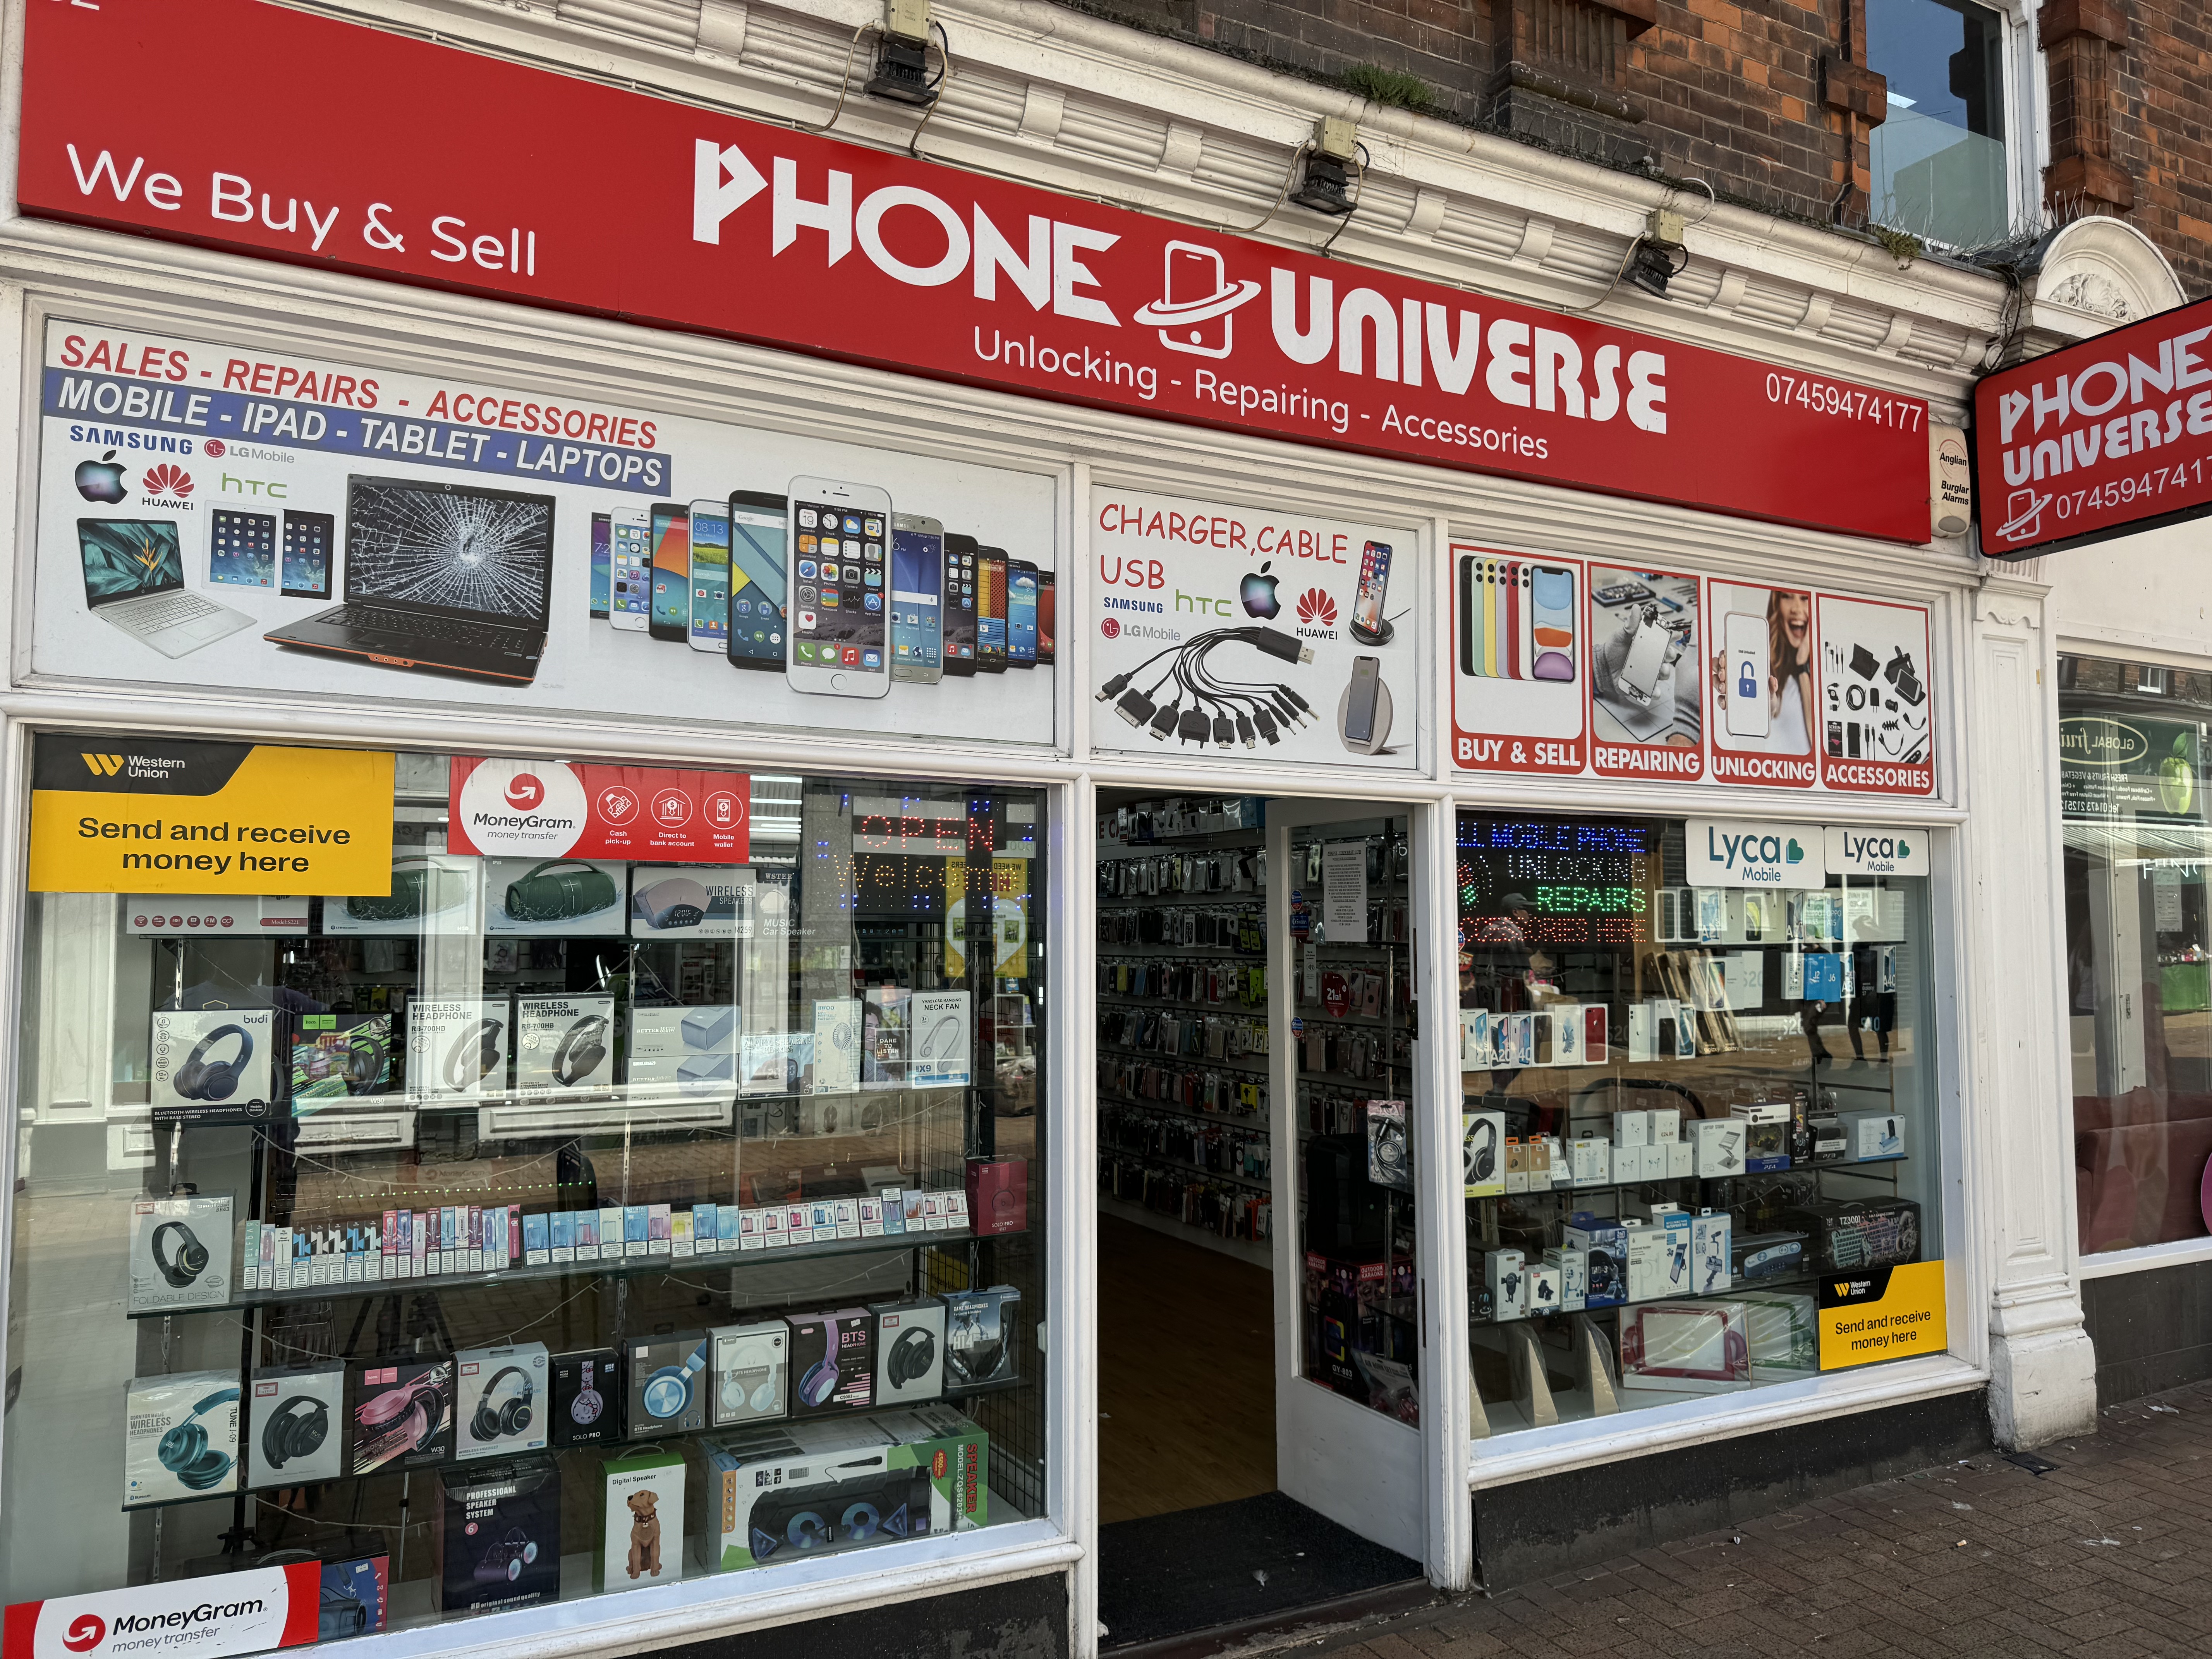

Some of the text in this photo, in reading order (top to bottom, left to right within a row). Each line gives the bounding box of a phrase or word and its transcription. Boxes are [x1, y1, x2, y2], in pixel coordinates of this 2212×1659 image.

[67, 143, 535, 276] We Buy & Sell
[693, 138, 1122, 327] PHONE
[1271, 266, 1667, 434] UNIVERSE
[60, 335, 657, 449] SALES REPAIRS ACCESSORIES
[975, 326, 1548, 459] Unlocking Repairing Accessories
[1999, 325, 2212, 445] PHONE
[1766, 373, 1922, 432] 07459474177
[58, 377, 663, 487] MOBILE IPAD TABLET LAPTOPS
[70, 425, 192, 455] SAMSUNG
[2002, 389, 2212, 486] UNIVERSE
[230, 446, 295, 464] LG Mobile
[1939, 452, 1967, 467] Anglian
[222, 472, 287, 499] htc
[1941, 480, 1969, 496] Burglar
[142, 497, 194, 510] HUAWEI
[1942, 492, 1969, 506] Alarms
[695, 522, 723, 534] 08:13
[803, 515, 814, 525] 19
[1099, 503, 1348, 564] CHARGER,CABLE
[1100, 555, 1165, 589] USB
[1104, 597, 1163, 614] SAMSUNG
[1175, 589, 1232, 617] htc
[1123, 624, 1181, 641] LG Mobile
[1297, 627, 1338, 640] HUAWEI
[129, 755, 185, 768] Western
[1458, 739, 1581, 768] BUY & SELL
[1595, 748, 1700, 774] REPAIRING
[129, 766, 168, 779] Union
[1712, 755, 1815, 782] UNLOCKING
[1826, 763, 1930, 789] ACCESSORIES
[474, 813, 574, 830] MoneyGram
[78, 817, 350, 845] Send and receive
[488, 831, 558, 840] money transfer
[862, 814, 993, 851] OPEN
[1578, 826, 1646, 852] PHONE
[605, 838, 631, 846] pick-up
[1709, 826, 1781, 869] Lyca
[1844, 832, 1893, 862] Lyca
[122, 852, 309, 875] money here
[834, 854, 1017, 890] Welcome
[1509, 854, 1645, 882] UNLOCKING
[1867, 862, 1894, 872] Mobile
[1743, 867, 1781, 881] Mobile
[706, 886, 753, 896] WIRELESS
[1538, 886, 1646, 912] REPAIRS
[780, 928, 816, 937] Speaker
[1597, 918, 1645, 942] HERE
[1828, 974, 1836, 982] J6
[412, 1004, 461, 1012] WIRELESS
[522, 1001, 568, 1010] WIRELESS
[522, 1009, 579, 1018] HEADPHONE
[244, 1014, 268, 1024] budi
[413, 1012, 472, 1020] HEADPHONE
[1361, 1265, 1383, 1273] OUTDOOR
[1361, 1270, 1384, 1279] KARAOKE
[1850, 1280, 1871, 1288] Western
[1850, 1287, 1865, 1295] Union
[134, 1290, 225, 1305] FOLDABLE DESIGN
[1836, 1310, 1931, 1335] Send and receive
[842, 1331, 866, 1343] BTS
[953, 1334, 973, 1350] H14
[1851, 1329, 1917, 1351] money here
[1332, 1364, 1352, 1377] GY-803
[130, 1417, 171, 1430] WIRELESS
[229, 1407, 237, 1428] TUNE
[130, 1427, 163, 1436] HEADPHONES
[572, 1433, 588, 1441] SOLO
[612, 1474, 657, 1486] Digital Speaker
[966, 1443, 977, 1514] SPEAKER
[466, 1486, 516, 1500] PROFESSIOANL
[466, 1499, 497, 1510] SPEAKER
[466, 1508, 494, 1519] SYSTEM
[468, 1525, 474, 1533] 6
[471, 1602, 480, 1611] HD
[481, 1597, 503, 1608] original
[520, 1591, 541, 1602] quality
[113, 1597, 264, 1636] MoneyGram
[112, 1626, 220, 1653] money transfer
